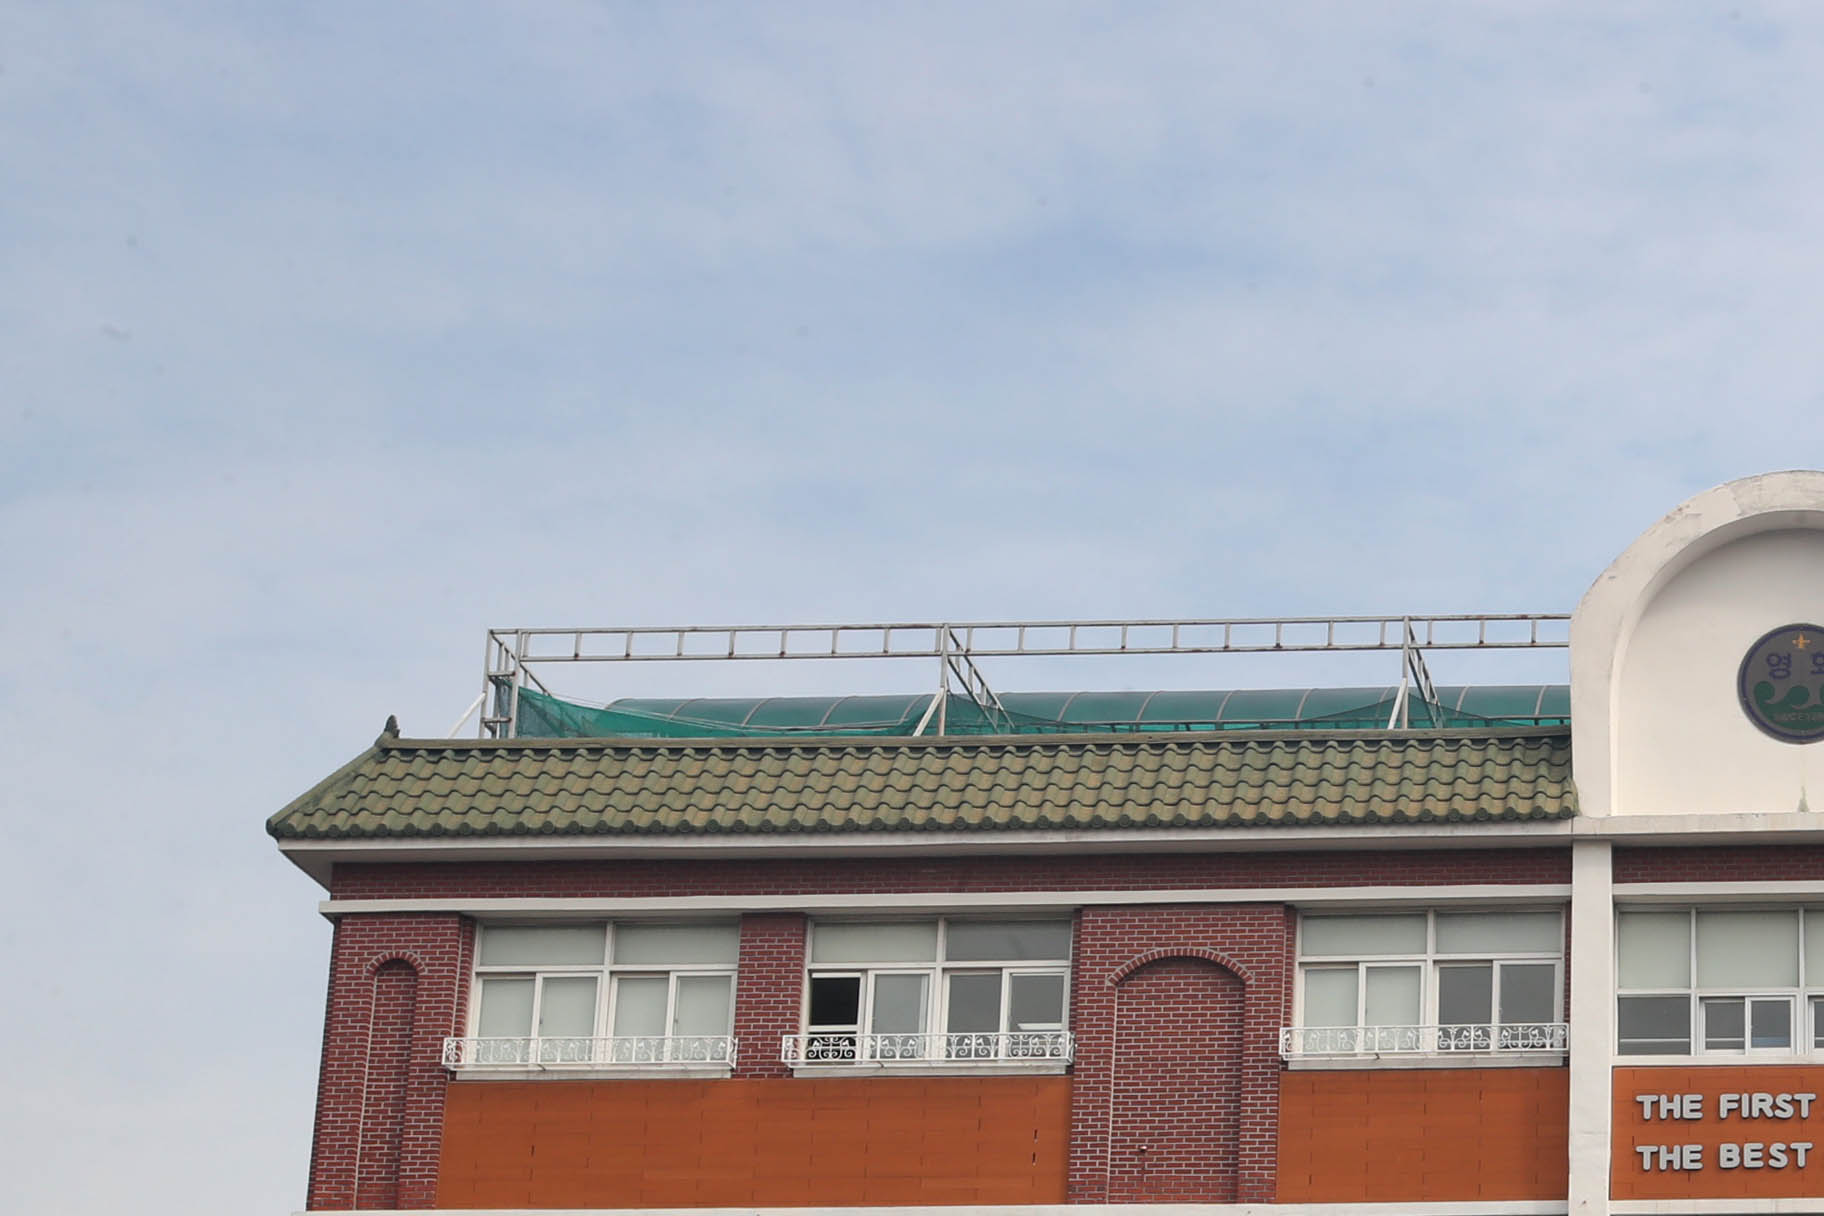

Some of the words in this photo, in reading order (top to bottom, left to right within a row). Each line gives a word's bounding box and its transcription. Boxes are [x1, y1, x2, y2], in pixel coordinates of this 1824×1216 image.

[1635, 1094, 1703, 1120] THE
[1719, 1092, 1816, 1120] FIRST
[1635, 1144, 1703, 1171] THE
[1719, 1142, 1813, 1169] BEST
